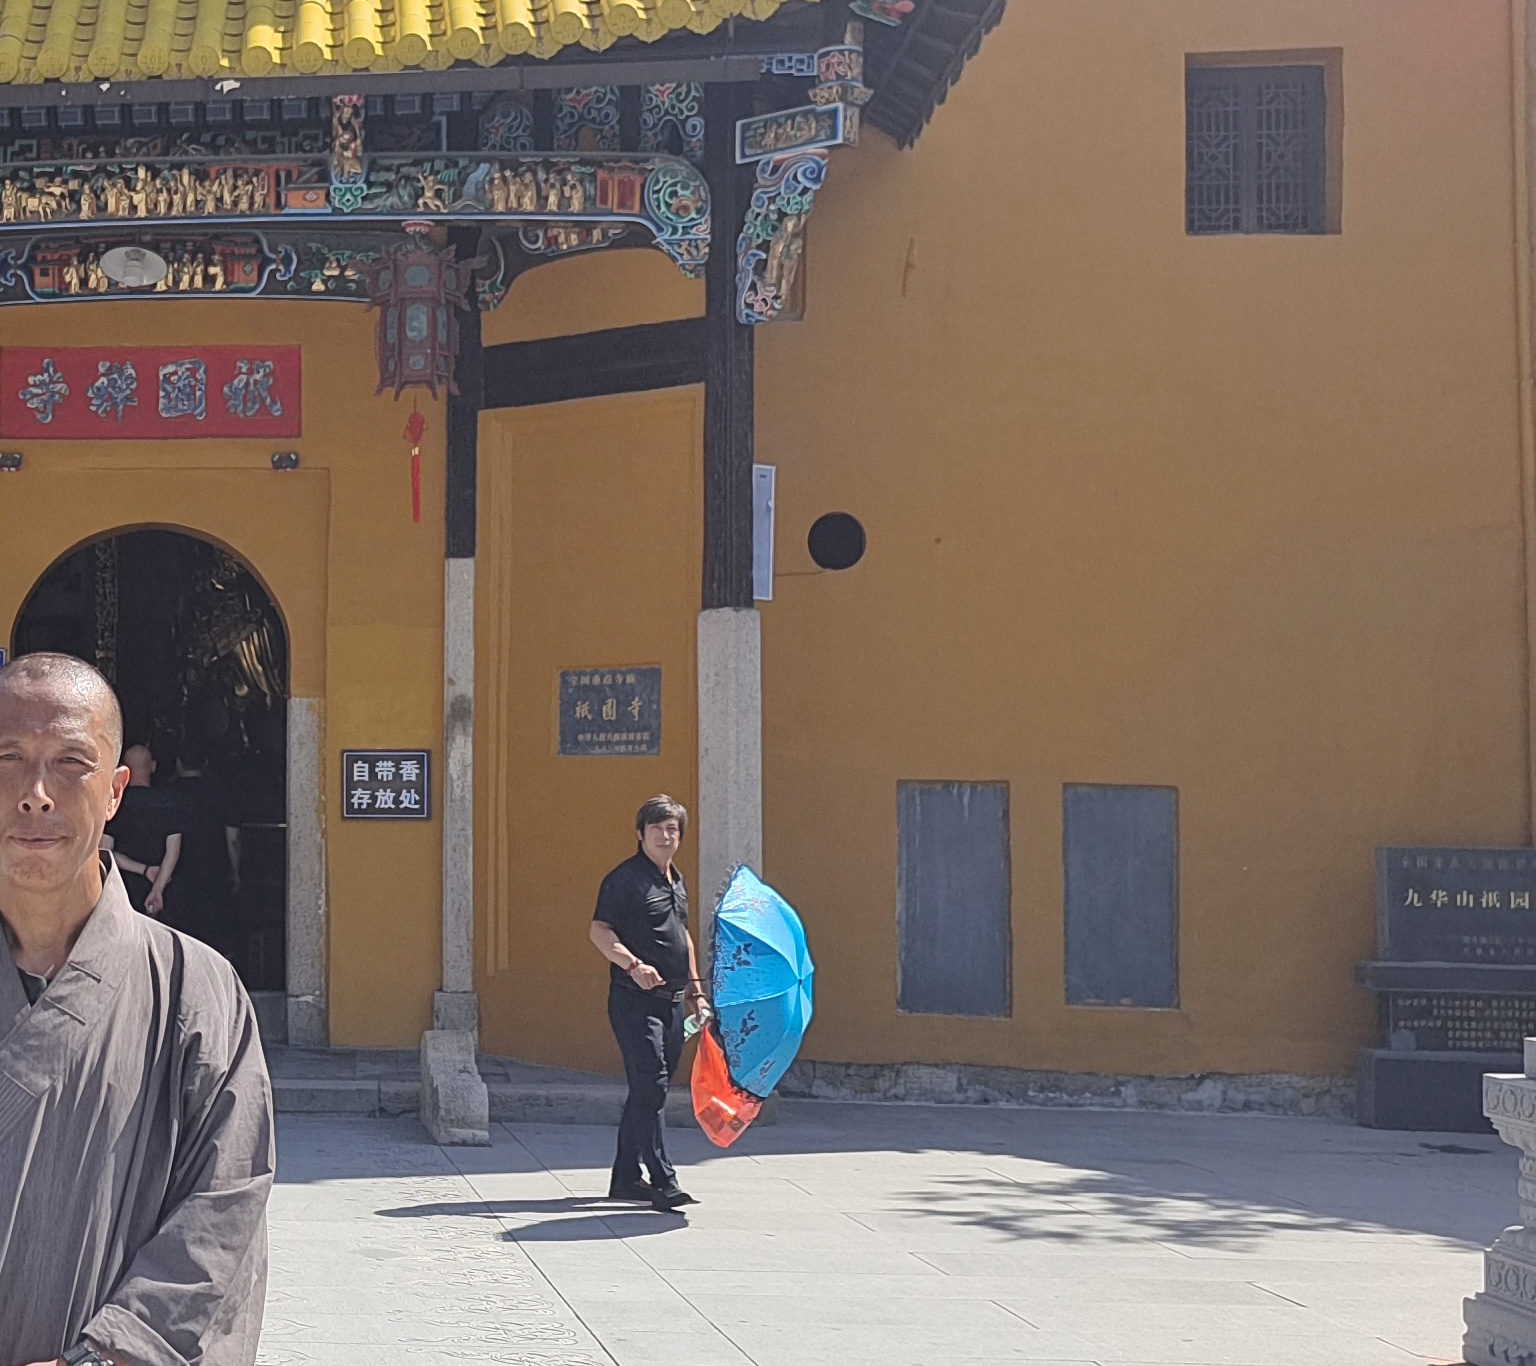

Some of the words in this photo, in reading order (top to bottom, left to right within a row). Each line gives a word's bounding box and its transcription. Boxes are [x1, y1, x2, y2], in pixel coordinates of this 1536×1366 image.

[352, 759, 421, 782] 自带香
[350, 787, 421, 810] 存放处
